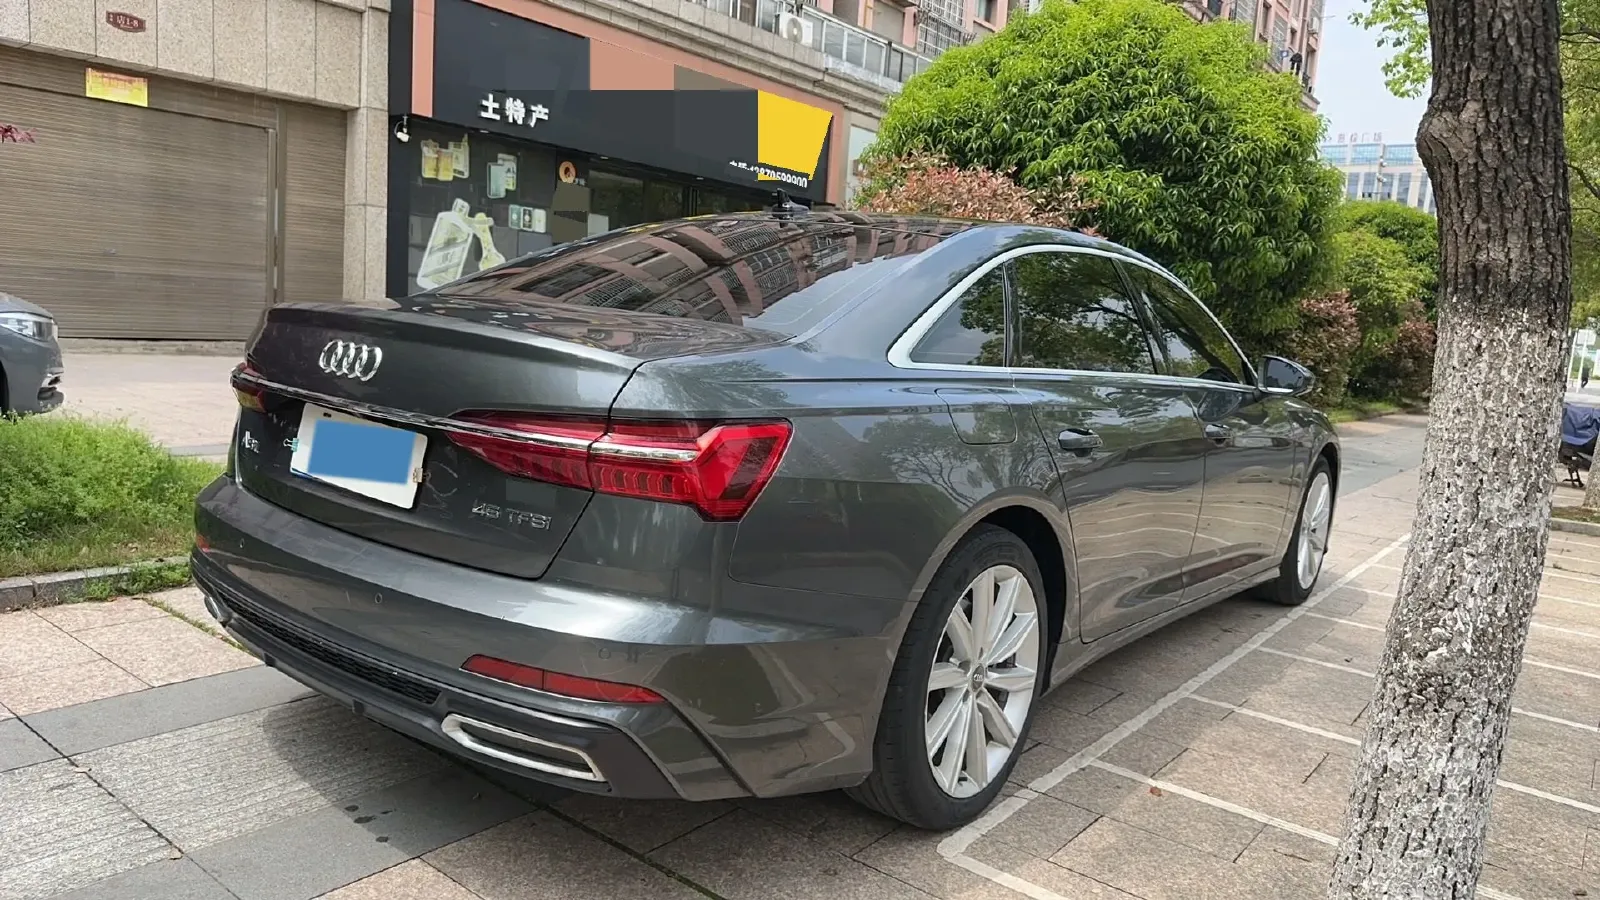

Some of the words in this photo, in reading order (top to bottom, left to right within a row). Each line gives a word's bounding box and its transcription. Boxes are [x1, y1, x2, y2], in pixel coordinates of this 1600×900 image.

[480, 92, 549, 128] 土特产
[505, 507, 552, 530] TFSI
